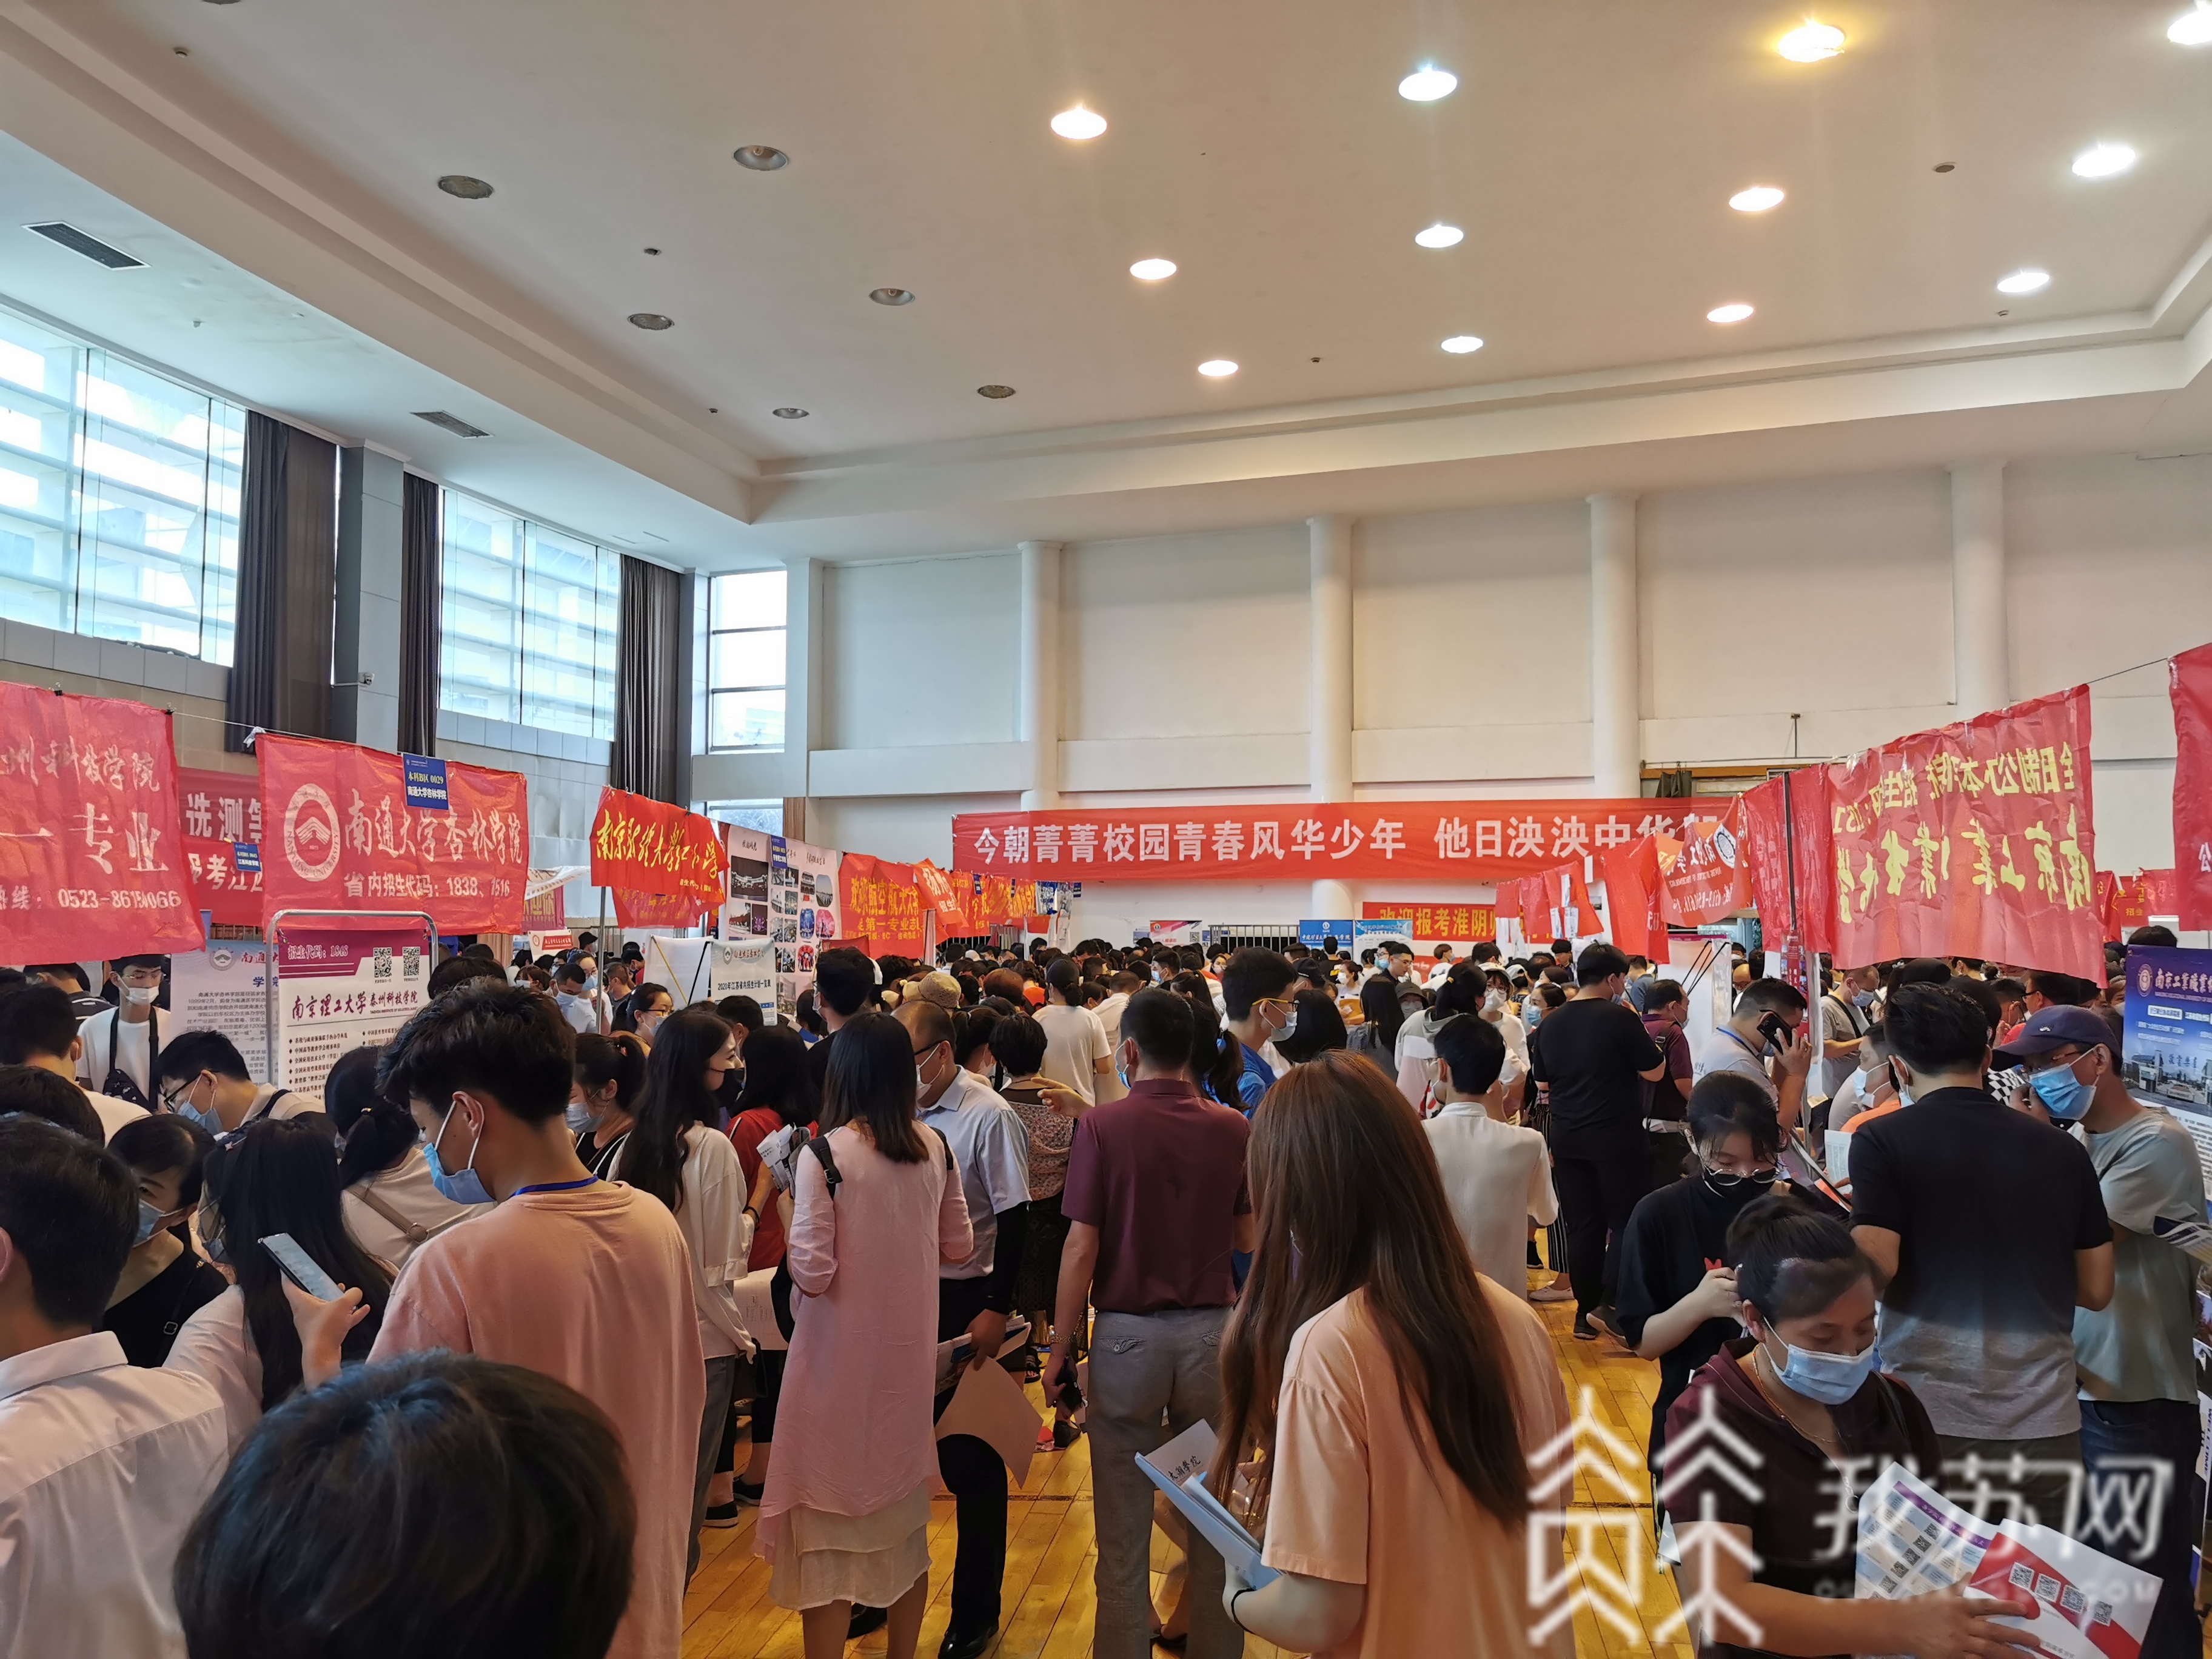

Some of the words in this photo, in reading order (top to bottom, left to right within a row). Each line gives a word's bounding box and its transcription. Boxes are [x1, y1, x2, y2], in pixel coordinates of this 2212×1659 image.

[407, 785, 447, 800] 南通大学杏林学院
[345, 788, 523, 865] 南通大学杏林学院
[973, 818, 1406, 865] 今朝菁菁校园青春风华少年
[1433, 813, 1718, 859] 他日泱泱中华
[717, 979, 771, 991] 2020年江苏省内招生计划一览表
[292, 991, 366, 1021] 南京理工大学
[369, 990, 418, 1008] 泰州科技学院
